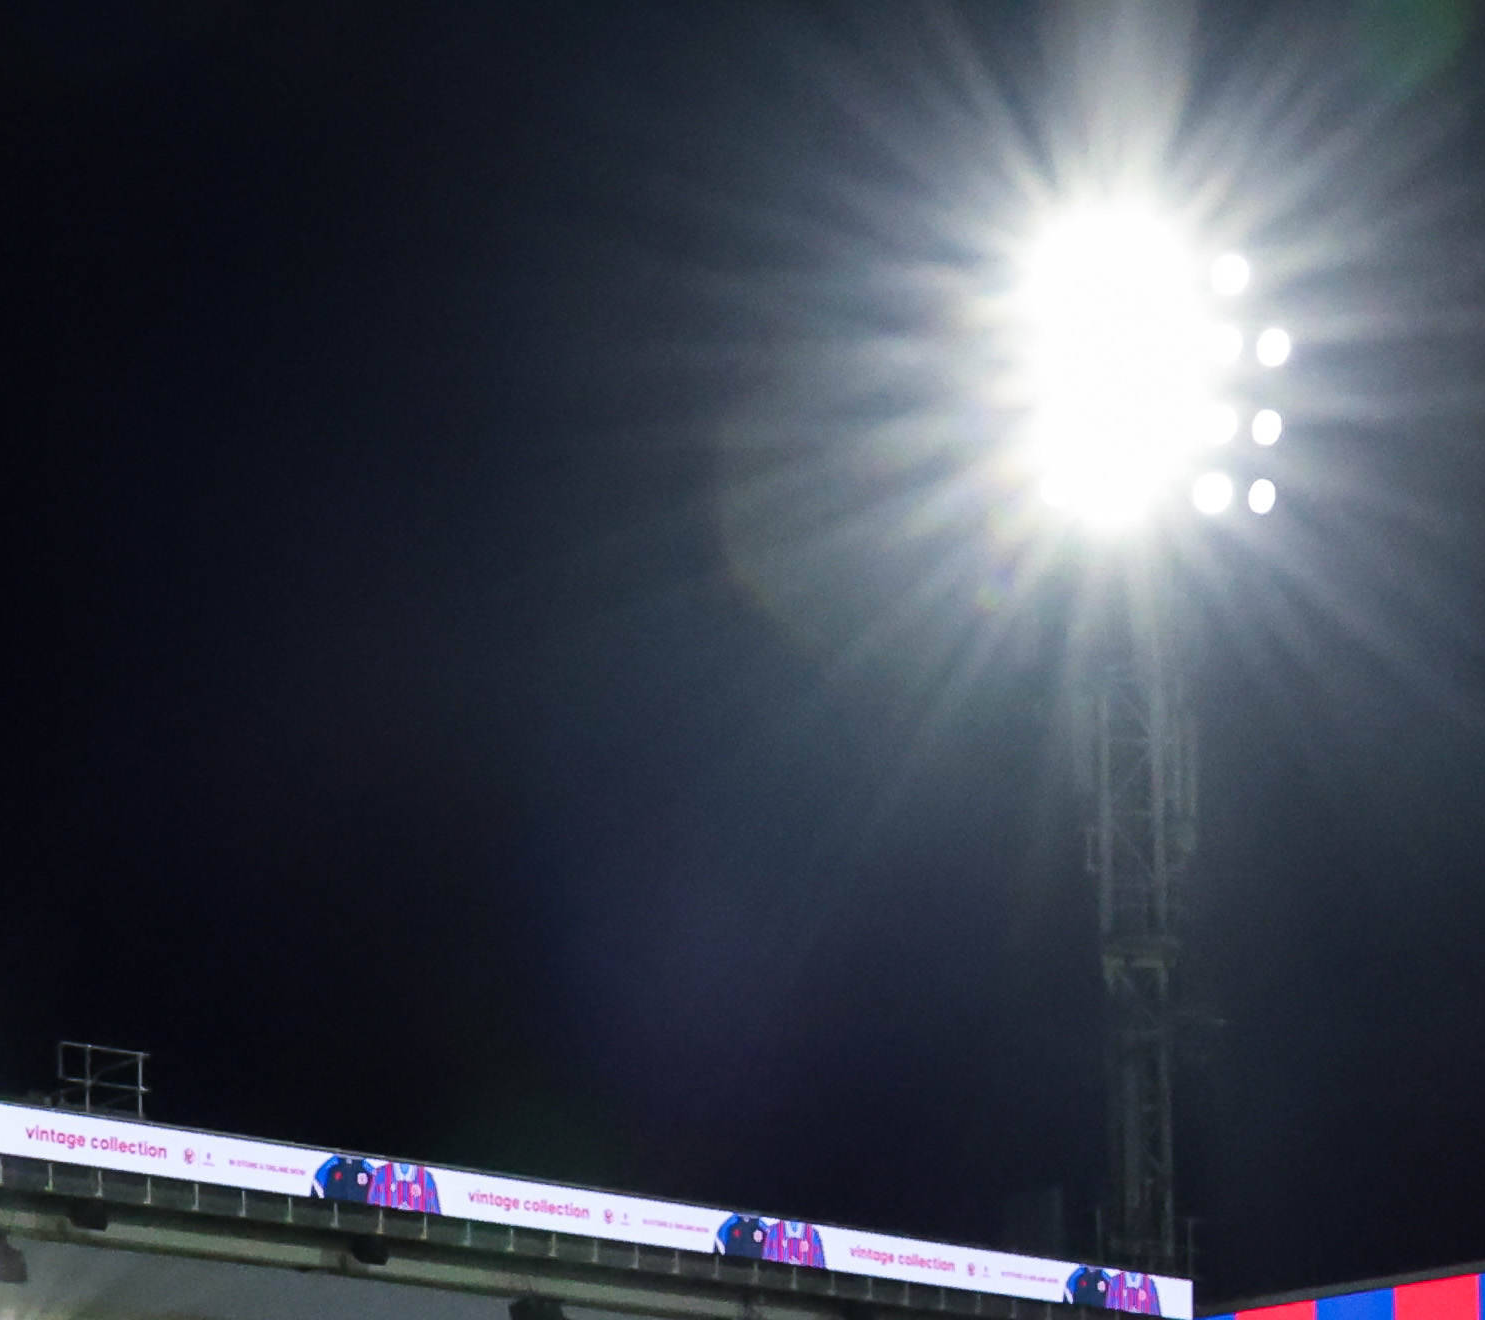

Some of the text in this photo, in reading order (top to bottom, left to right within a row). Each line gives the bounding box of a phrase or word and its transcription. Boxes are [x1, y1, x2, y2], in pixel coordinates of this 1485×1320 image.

[25, 1124, 167, 1159] vintage collection
[467, 1189, 590, 1219] vintage collection
